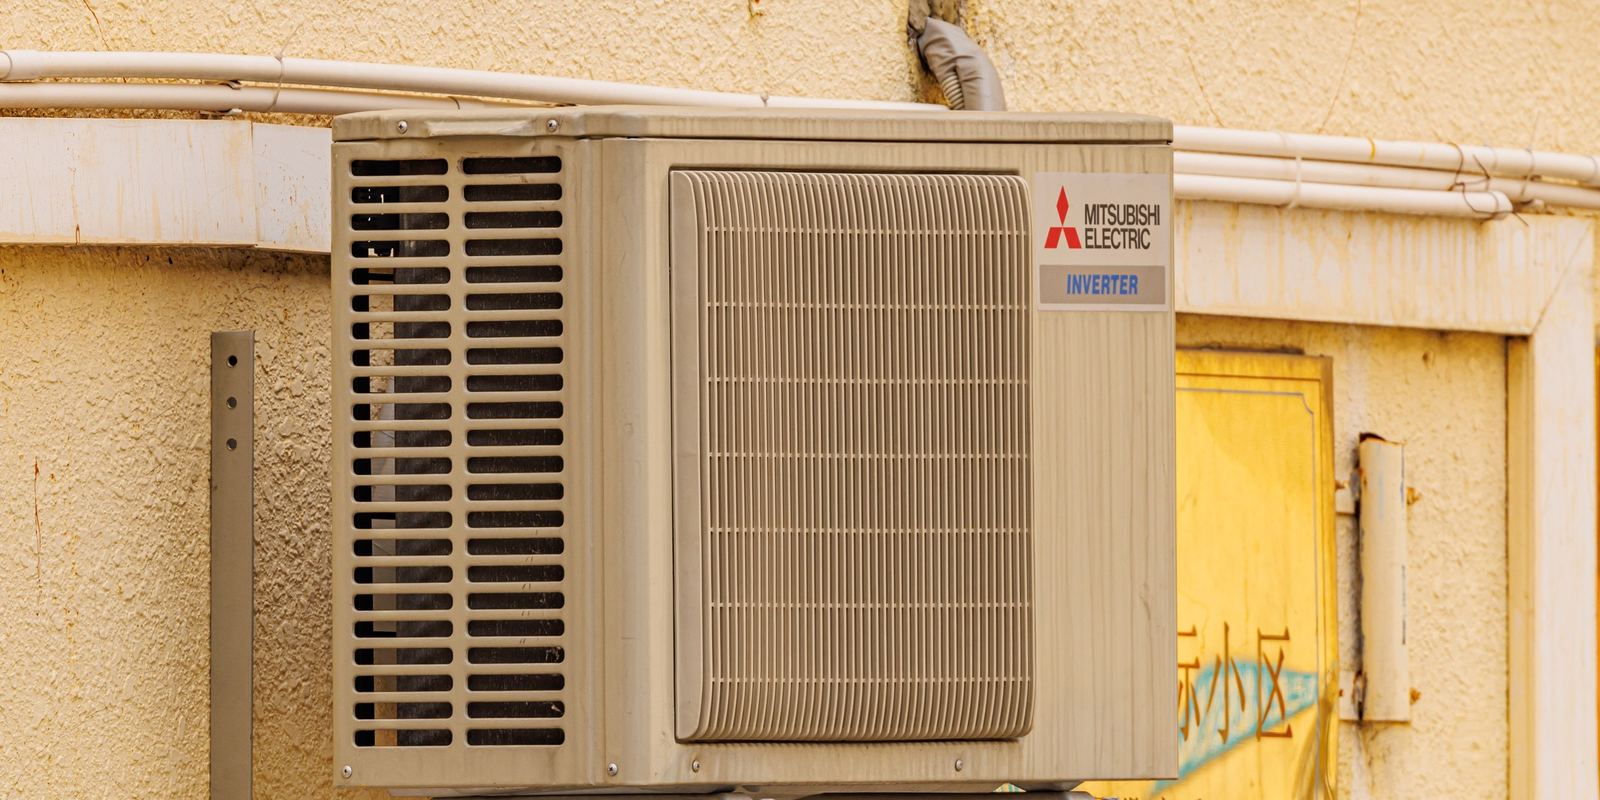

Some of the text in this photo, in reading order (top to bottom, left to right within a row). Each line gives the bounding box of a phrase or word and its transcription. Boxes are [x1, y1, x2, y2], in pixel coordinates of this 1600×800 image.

[1084, 203, 1160, 226] MITSUBISHI
[1084, 227, 1151, 250] ELECTRIC
[1066, 273, 1138, 295] INVERTER
